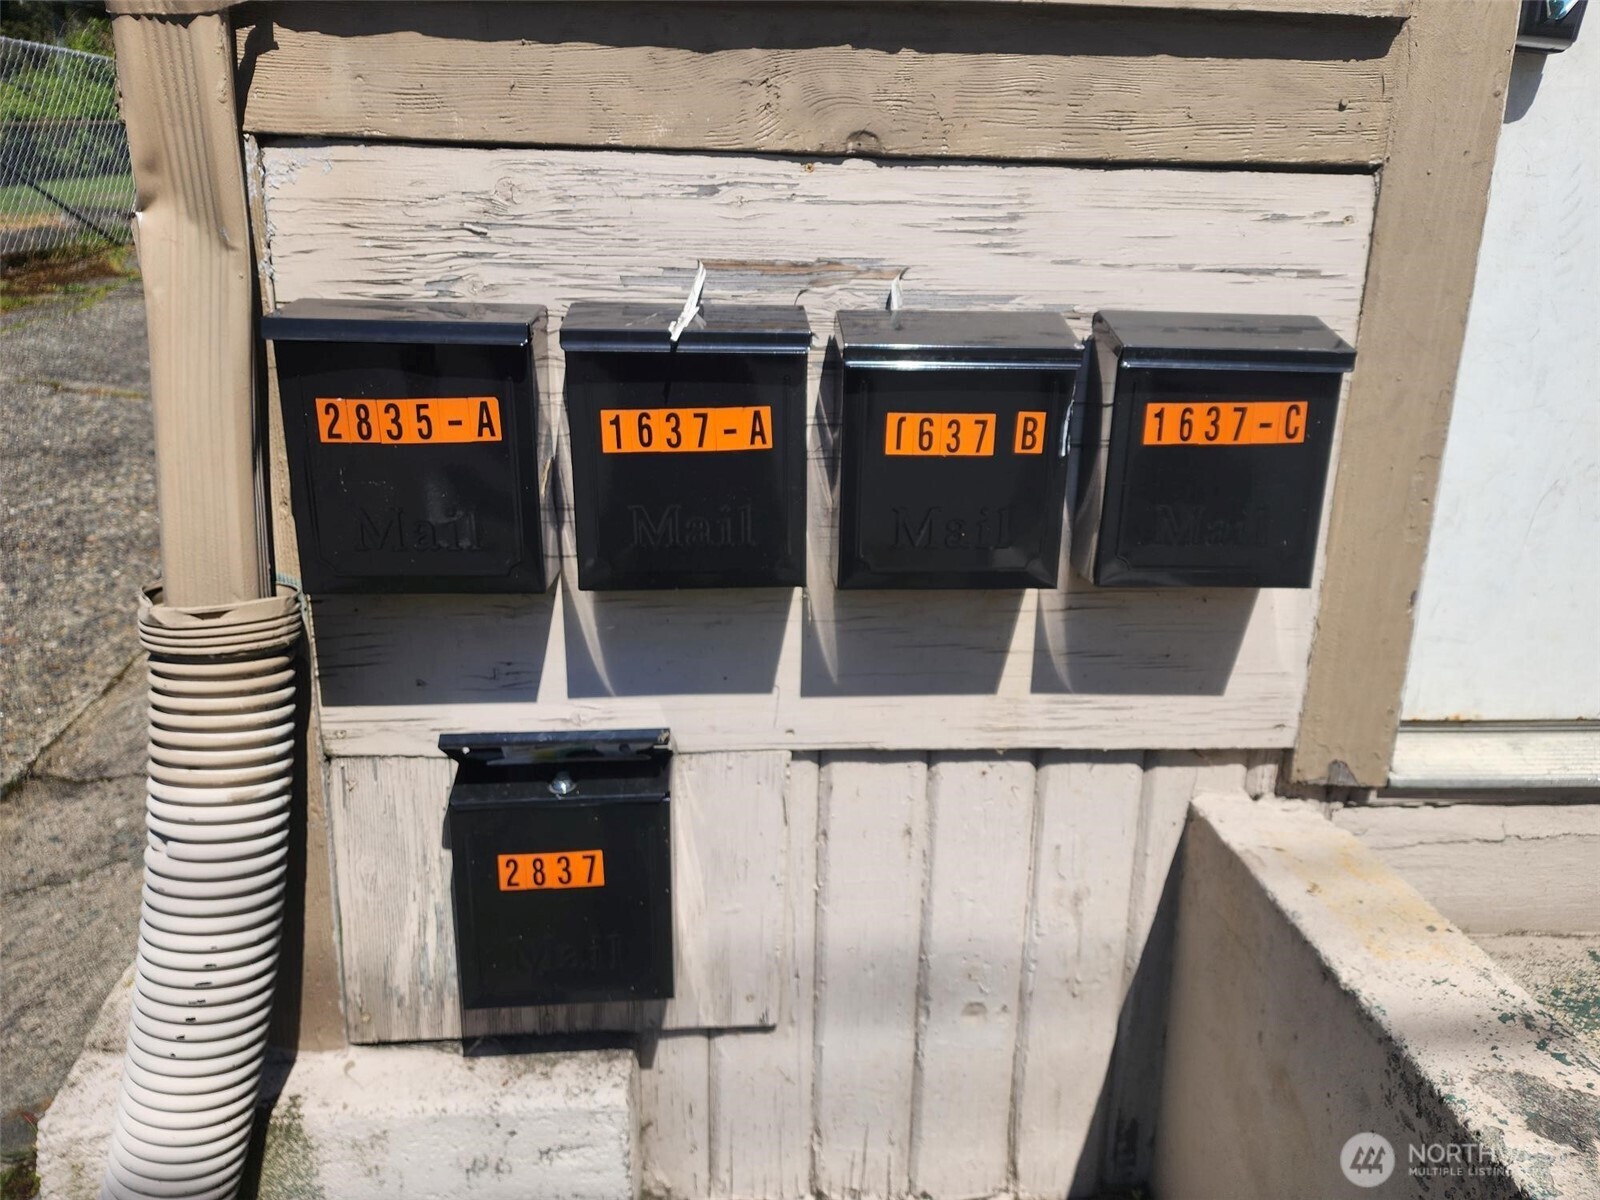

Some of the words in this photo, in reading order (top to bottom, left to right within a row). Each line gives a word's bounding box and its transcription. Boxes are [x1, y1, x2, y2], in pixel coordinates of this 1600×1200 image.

[323, 400, 496, 442] 2835-A
[609, 409, 767, 450] 1637-A
[1020, 416, 1038, 451] B
[1153, 403, 1301, 443] 1637-C
[353, 507, 483, 552] Mail
[626, 502, 757, 549] Mail
[890, 504, 1015, 550] Mail
[1153, 503, 1270, 549] Mail
[505, 854, 597, 888] 2837
